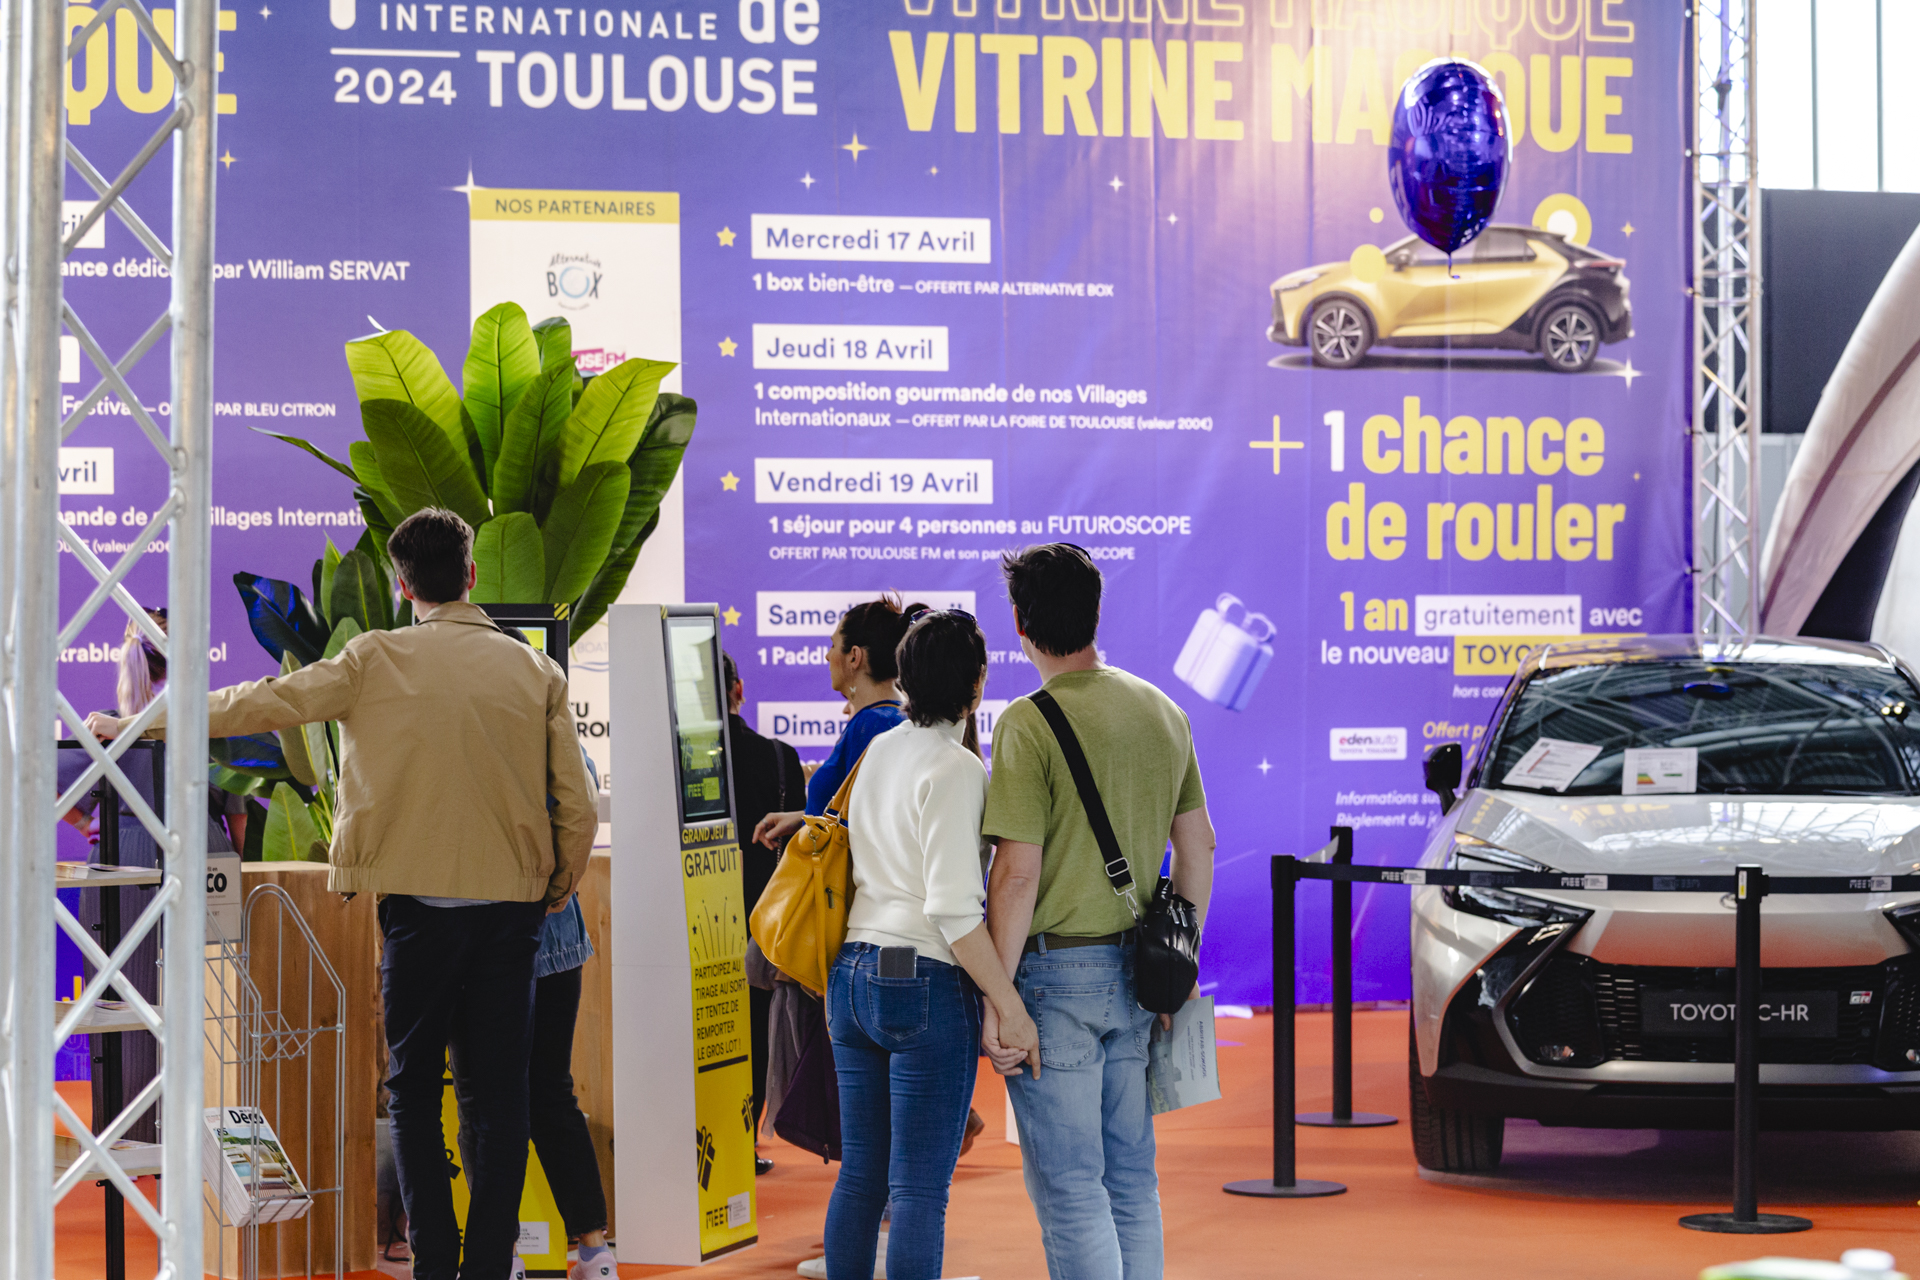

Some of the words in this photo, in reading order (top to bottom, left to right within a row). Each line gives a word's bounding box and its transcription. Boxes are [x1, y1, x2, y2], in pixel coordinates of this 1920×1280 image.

[380, 3, 717, 41] INTERNATIONALE
[334, 66, 457, 105] 2024
[476, 49, 818, 115] TOULOUSE
[888, 30, 1244, 140] VITRINE
[496, 199, 533, 214] NOS
[538, 200, 656, 216] PARTENAIRES
[766, 227, 879, 250] Mercredi
[887, 232, 910, 250] 17
[918, 231, 975, 252] Avril
[113, 257, 173, 278] dédic
[248, 259, 324, 280] William
[329, 260, 410, 281] SERVAT
[752, 272, 762, 291] 1
[767, 271, 804, 291] box
[809, 272, 895, 293] bien-être
[915, 279, 972, 295] OFFERTE
[974, 280, 1000, 295] PAR
[1001, 281, 1086, 297] ALTERNATIVE
[1087, 283, 1114, 297] BOX
[767, 338, 835, 359] Jeudi
[843, 340, 867, 359] 18
[876, 339, 933, 360] Avril
[754, 382, 764, 400] 1
[768, 381, 891, 404] composition
[895, 383, 1009, 406] gourmande
[1011, 383, 1036, 403] de
[1040, 388, 1073, 403] nos
[1076, 384, 1148, 408] Villages
[215, 402, 242, 416] PAR
[244, 402, 279, 417] BLEU
[281, 402, 336, 417] CITRON
[755, 407, 891, 427] Internationaux
[911, 414, 961, 428] OFFERT
[963, 414, 988, 428] PAR
[990, 415, 1008, 428] LA
[1009, 415, 1047, 429] FOIRE
[1049, 415, 1066, 429] DE
[1068, 415, 1135, 430] TOULOUSE
[1323, 410, 1345, 472] 1
[1362, 396, 1604, 476] chance
[58, 461, 97, 482] vril
[768, 472, 881, 493] Vendredi
[890, 474, 914, 493] 19
[922, 473, 979, 494] Avril
[121, 507, 148, 526] de
[211, 507, 272, 530] illages
[278, 506, 366, 526] Internati
[769, 516, 779, 534] 1
[783, 514, 845, 538] séjour
[849, 518, 896, 538] pour
[899, 516, 913, 534] 4
[917, 518, 1017, 538] personnes
[1020, 520, 1042, 534] au
[1048, 515, 1192, 535] FUTUROSCOPE
[1326, 482, 1407, 560] de
[1427, 484, 1626, 561] rouler
[769, 546, 820, 560] OFFERT
[822, 546, 848, 560] PAR
[850, 546, 919, 560] TOULOUSE
[921, 546, 941, 560] FM
[943, 548, 956, 560] et
[958, 550, 979, 560] son
[1340, 592, 1354, 631] 1
[1364, 599, 1408, 631] an
[1424, 603, 1577, 631] gratuitement
[1589, 608, 1643, 627] avec
[758, 648, 767, 665] 1
[772, 646, 830, 665] Paddl
[1321, 639, 1343, 665] le
[1349, 645, 1449, 665] nouveau
[1452, 684, 1480, 698] hors
[1423, 721, 1469, 738] Offert
[1335, 790, 1419, 806] Informations
[1335, 812, 1405, 830] Règlement
[1408, 813, 1426, 826] du
[682, 826, 710, 844] GRAND
[710, 824, 724, 840] JEU
[684, 847, 737, 878] GRATUIT
[695, 963, 731, 981] PARTICIPEZ
[732, 960, 741, 973] AU
[695, 984, 718, 1001] TIRAGE
[720, 980, 729, 994] AU
[729, 978, 746, 995] SORT
[696, 1007, 704, 1021] ET
[705, 1002, 729, 1020] TENTEZ
[730, 999, 739, 1013] DE
[1670, 1003, 1736, 1021] TOYOT
[696, 1020, 735, 1041] REMPORTER
[697, 1047, 705, 1061] LE
[706, 1042, 725, 1058] GROS
[725, 1039, 737, 1056] LOT
